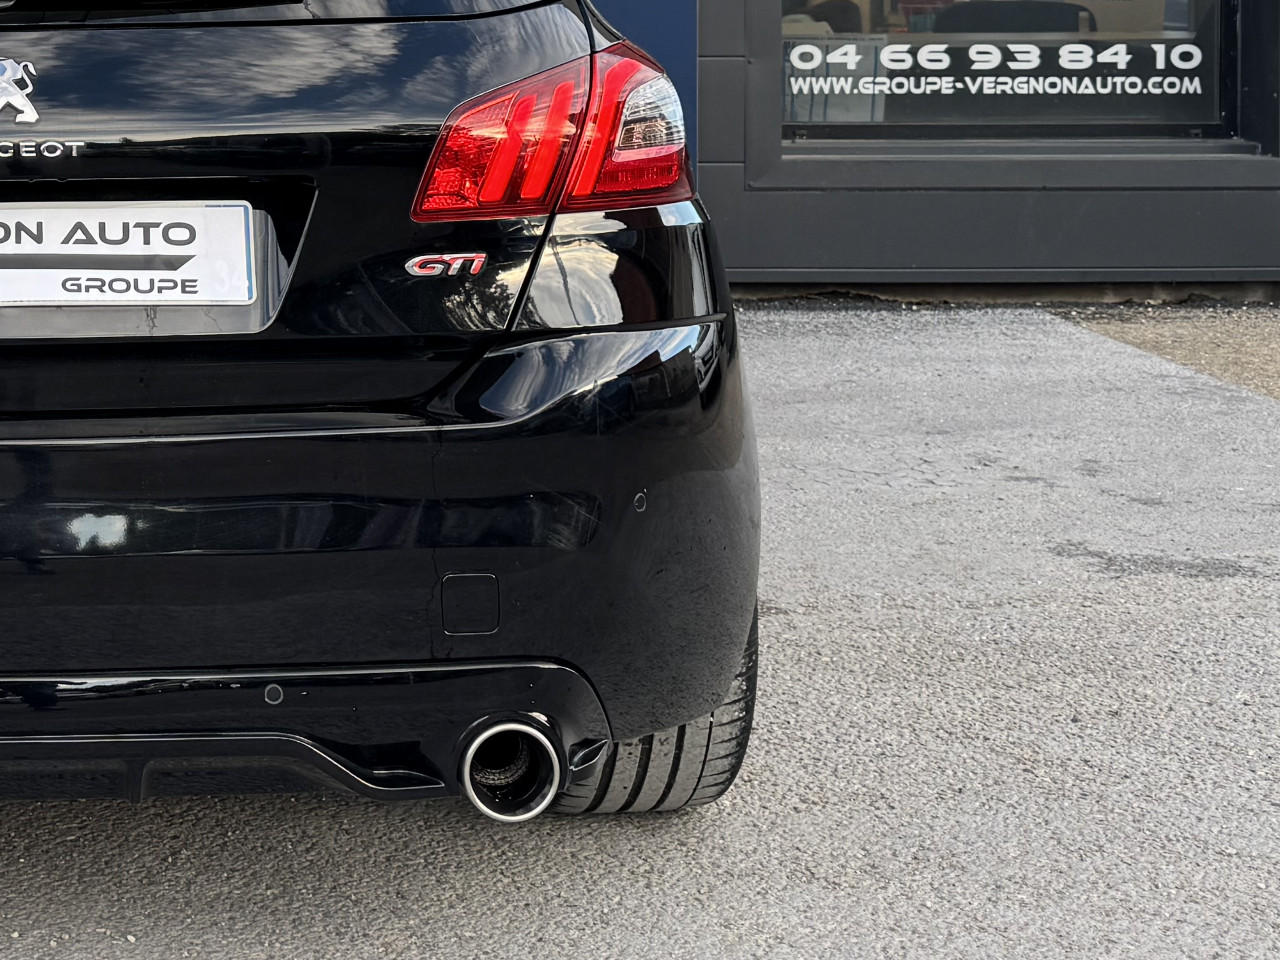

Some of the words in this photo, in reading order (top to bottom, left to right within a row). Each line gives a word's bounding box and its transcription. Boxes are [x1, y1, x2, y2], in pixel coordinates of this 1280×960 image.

[789, 44, 863, 70] 04
[879, 44, 951, 70] 66
[968, 44, 1041, 70] 93
[1058, 44, 1133, 70] 84
[1151, 44, 1203, 70] 10
[789, 76, 1202, 95] WWW.GROUPE-VERGNONAUTO.COM
[59, 221, 197, 247] AUTO
[60, 277, 199, 295] GROUPE
